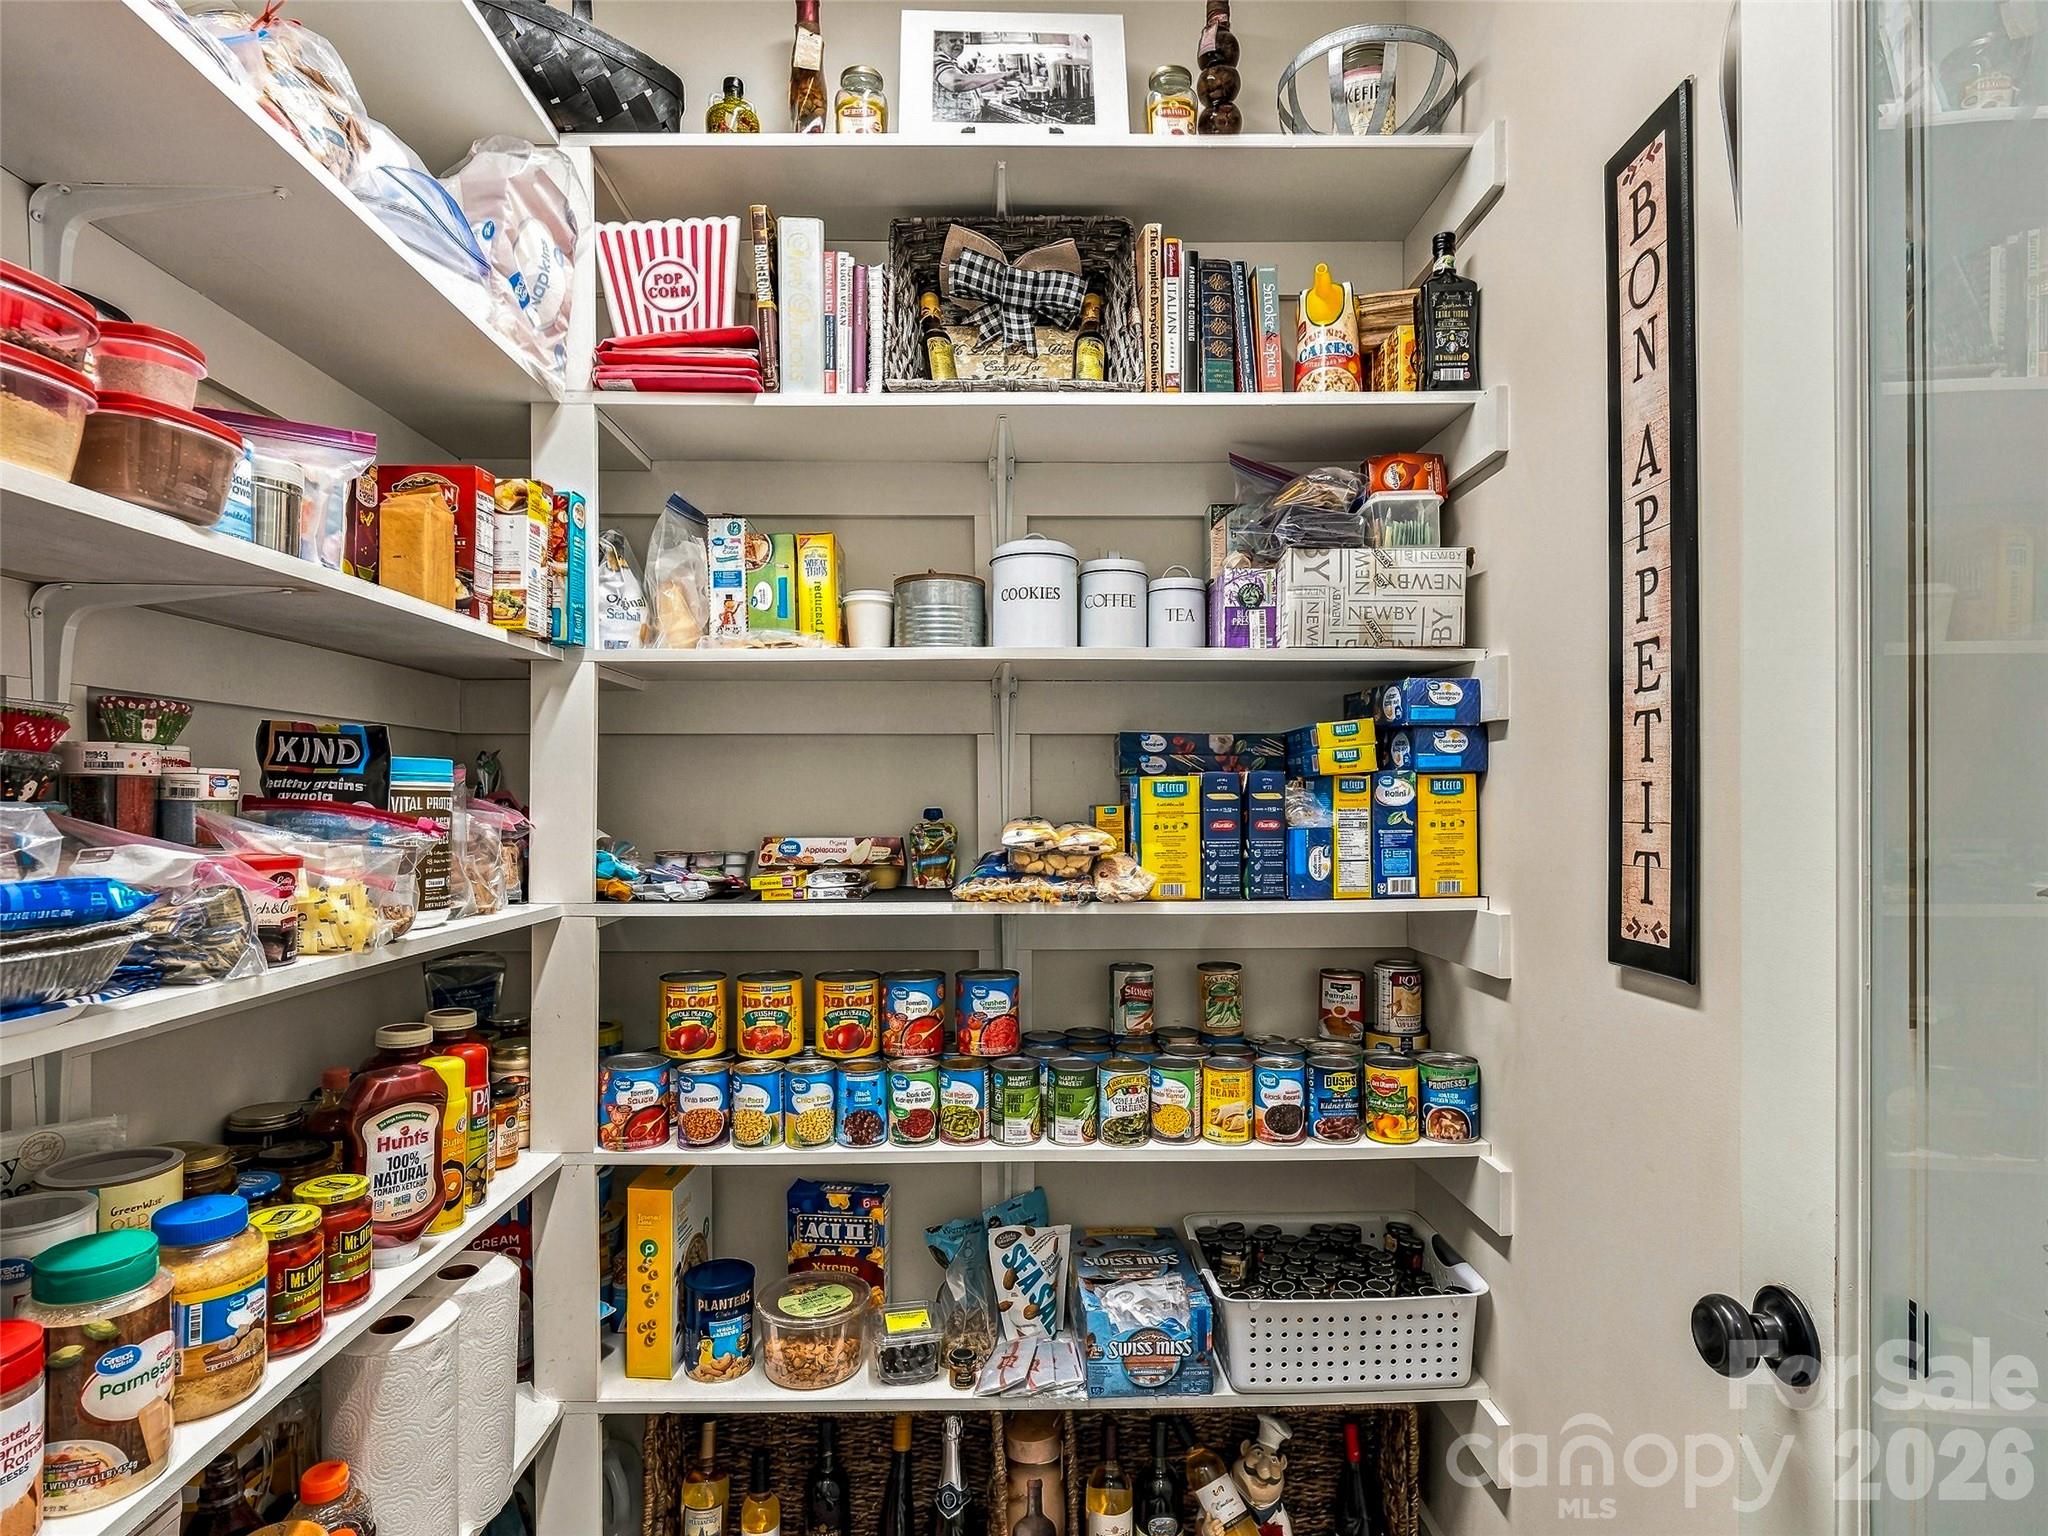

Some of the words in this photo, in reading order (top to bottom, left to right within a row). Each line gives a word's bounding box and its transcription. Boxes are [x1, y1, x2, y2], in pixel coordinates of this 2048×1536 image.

[1150, 228, 1159, 247] The
[653, 274, 682, 286] POP
[824, 257, 834, 288] VEGAN
[1150, 249, 1159, 294] Complete
[1628, 179, 1660, 383] BON
[648, 285, 691, 299] CORN
[839, 293, 848, 326] VEGAN
[1167, 281, 1177, 335] ITALIAN
[1263, 284, 1277, 330] Smoke
[1150, 296, 1160, 340] Everyday
[1266, 331, 1277, 341] &
[1048, 343, 1074, 356] Hom
[983, 360, 1019, 373] Except
[1024, 362, 1043, 375] for
[1150, 341, 1160, 392] Cookbook
[1263, 345, 1279, 378] Spice
[730, 523, 740, 532] 12
[1420, 551, 1464, 560] NEWBY
[1386, 573, 1462, 590] NEWBY
[606, 593, 647, 610] Original
[1001, 586, 1061, 602] COOKIES
[1084, 593, 1136, 610] COFFEE
[606, 607, 623, 620] Sea
[624, 608, 641, 622] Salt
[1165, 608, 1195, 622] TEA
[1332, 587, 1341, 626] NEWBY
[1348, 606, 1417, 621] NEWBY
[1631, 423, 1662, 906] APPETIT
[275, 736, 361, 765] KIND
[313, 776, 366, 792] grains
[1385, 789, 1407, 798] Rotini
[390, 796, 423, 813] VITAL
[427, 796, 453, 810] PROTE
[1324, 990, 1358, 1001] Pumpkin
[905, 1006, 928, 1014] Puree
[1325, 1075, 1357, 1088] BUSH'S
[1427, 1079, 1467, 1090] PROGRESSO
[473, 1088, 489, 1115] PA
[627, 1097, 654, 1105] Sauce
[630, 1089, 654, 1098] Tomato
[1210, 1088, 1241, 1098] BEANS
[1116, 1104, 1147, 1112] GREENS
[1320, 1102, 1344, 1110] Kidney
[377, 1128, 430, 1153] Hunt's
[386, 1151, 419, 1171] 100%
[373, 1164, 428, 1188] NATURAL
[373, 1186, 400, 1197] TOMATO
[401, 1178, 427, 1192] KETCHUP
[110, 1213, 150, 1230] OLD
[359, 1225, 372, 1245] Oli
[805, 1222, 842, 1239] ACT
[845, 1223, 866, 1240] II
[472, 1234, 520, 1250] CREAM
[347, 1250, 370, 1263] ROAST
[1083, 1256, 1135, 1267] SWISS
[0, 1262, 25, 1275] reat
[308, 1260, 322, 1282] Oli
[811, 1262, 859, 1275] Xtreme
[697, 1289, 751, 1312] PLANTERS
[1029, 1282, 1056, 1336] SAL
[101, 1349, 134, 1367] Great
[1107, 1341, 1153, 1360] SWISS
[110, 1358, 134, 1370] Value
[99, 1356, 172, 1400] Parmesa
[1, 1421, 31, 1446] ated
[0, 1462, 30, 1486] EESES
